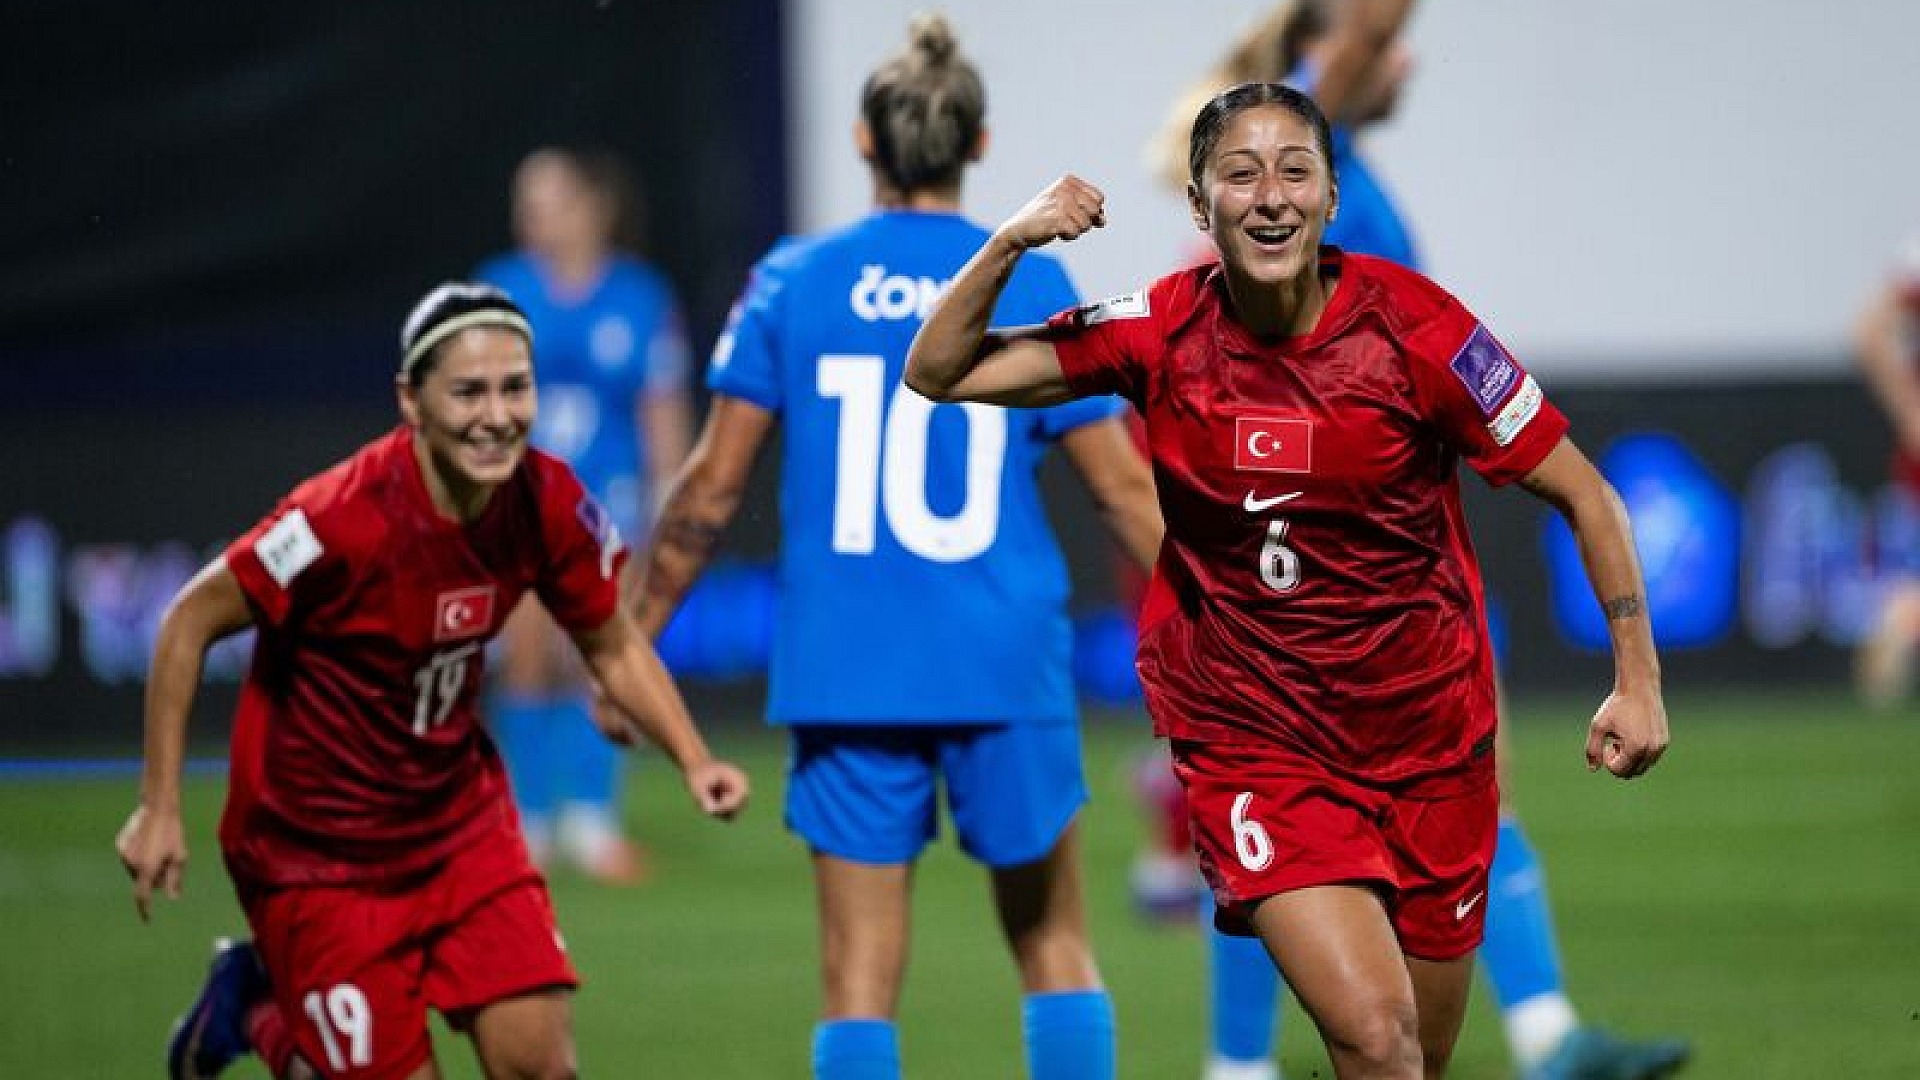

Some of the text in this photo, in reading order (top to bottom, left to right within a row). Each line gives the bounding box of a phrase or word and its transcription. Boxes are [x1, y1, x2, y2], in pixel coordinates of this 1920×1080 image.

[817, 354, 1006, 562] 10
[1260, 519, 1299, 590] 6
[413, 655, 468, 736] 19
[1231, 792, 1274, 871] 6
[304, 983, 372, 1070] 19
